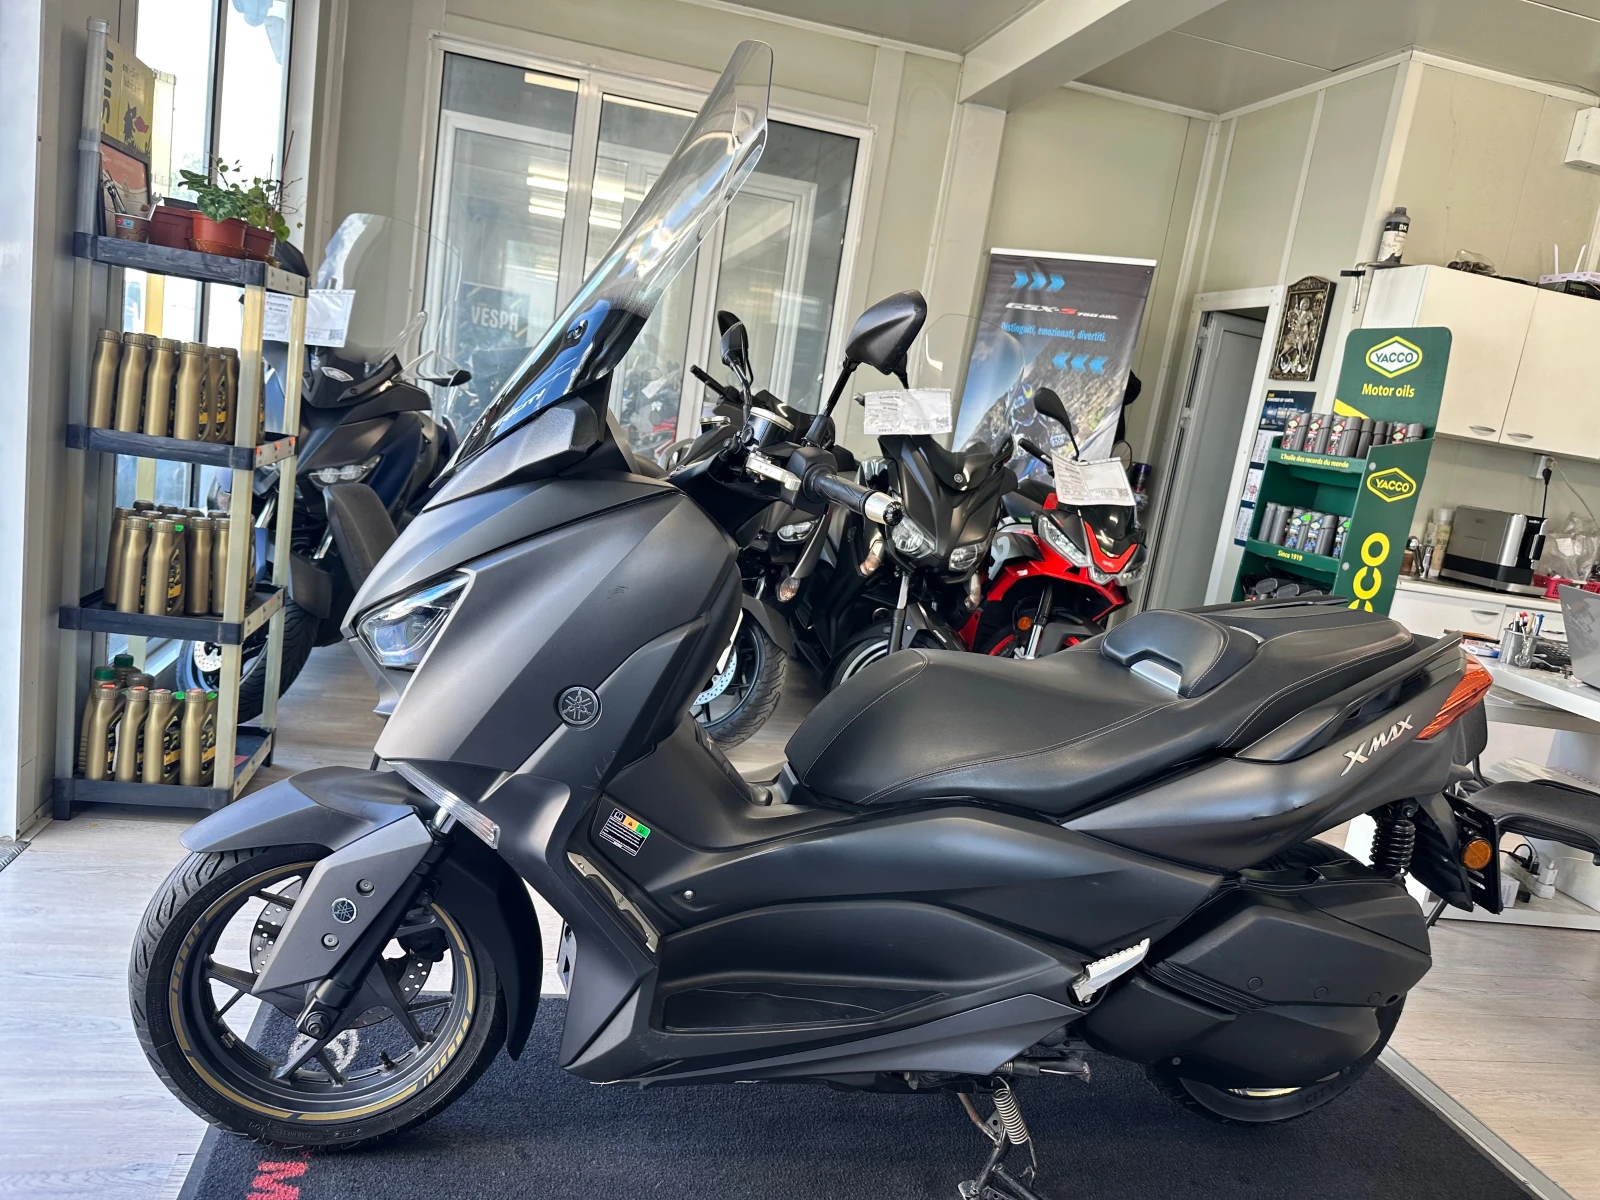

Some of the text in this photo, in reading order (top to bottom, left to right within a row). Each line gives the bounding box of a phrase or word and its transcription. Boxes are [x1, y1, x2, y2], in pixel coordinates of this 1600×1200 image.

[471, 305, 519, 332] VESPA
[1037, 326, 1076, 340] emozionati,
[1375, 352, 1414, 364] YACCO
[1361, 383, 1415, 398] Motor oils
[1296, 455, 1305, 463] des
[1323, 458, 1331, 466] du
[1331, 460, 1349, 468] monde
[1375, 478, 1410, 493] YACCO
